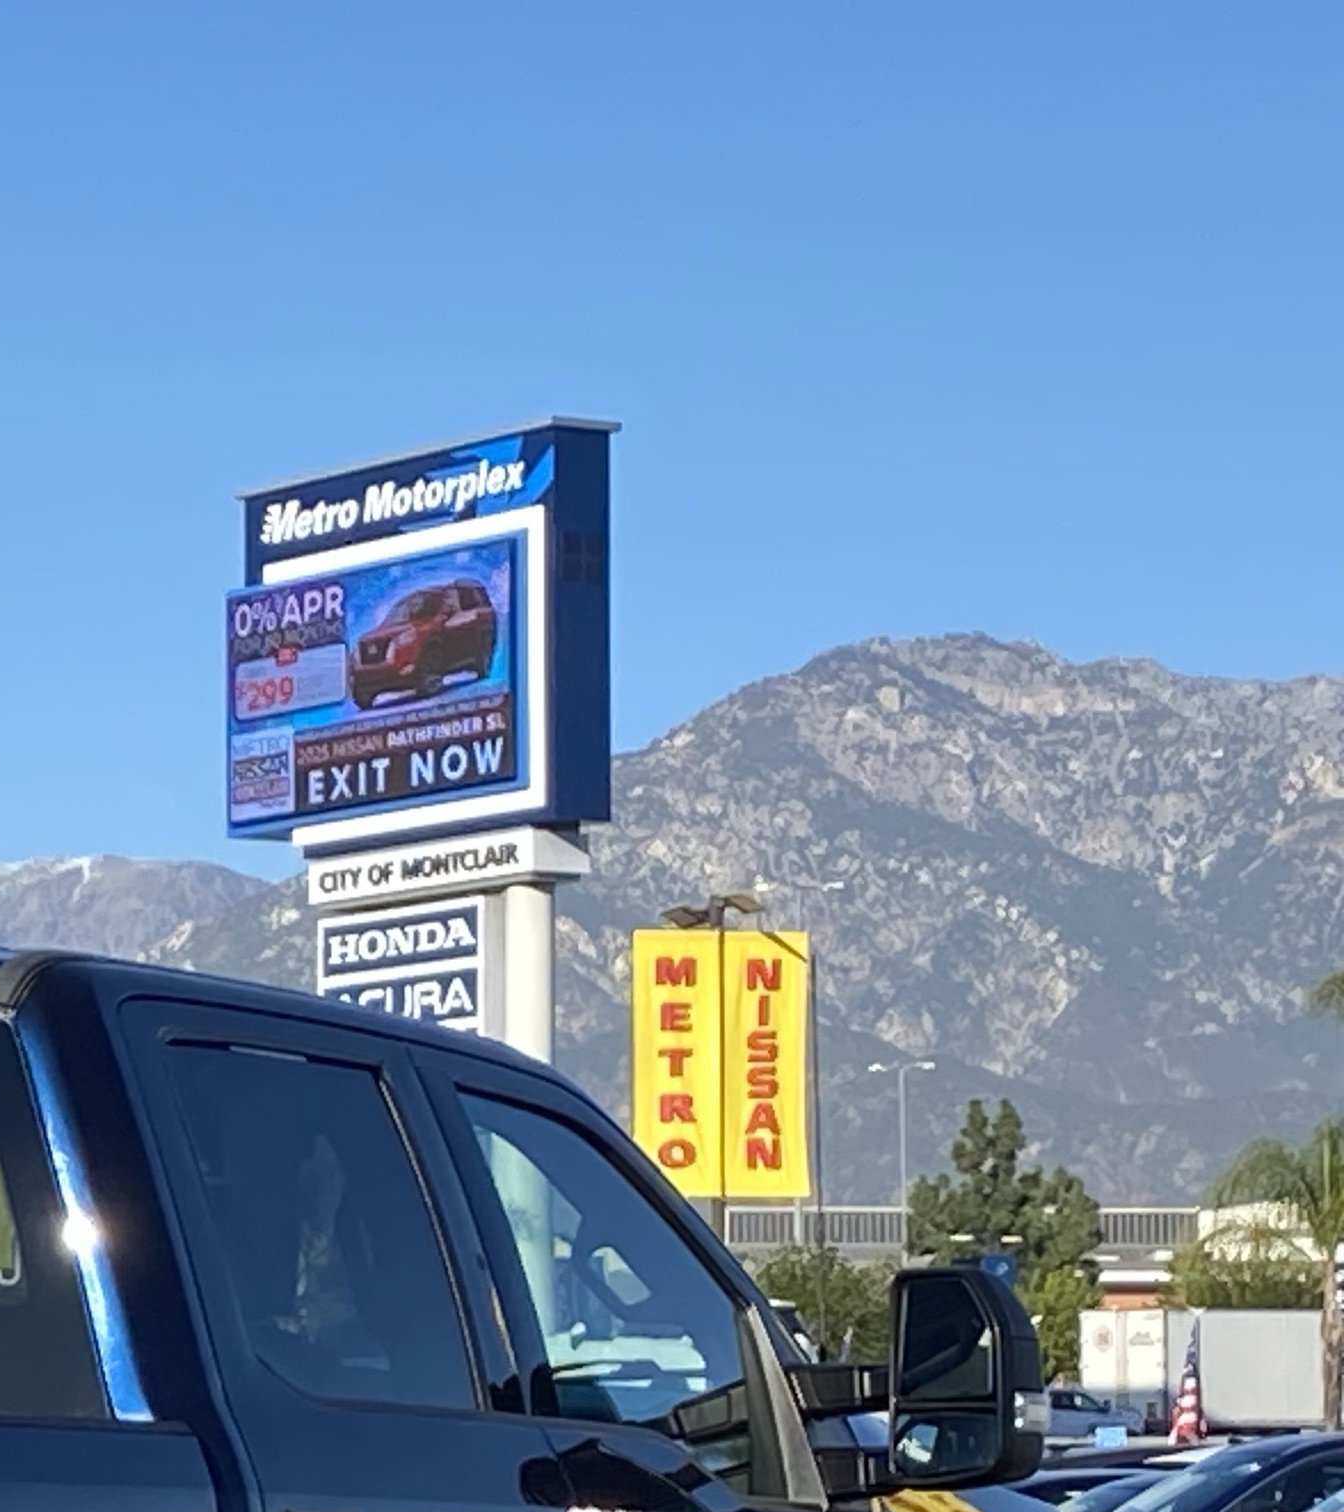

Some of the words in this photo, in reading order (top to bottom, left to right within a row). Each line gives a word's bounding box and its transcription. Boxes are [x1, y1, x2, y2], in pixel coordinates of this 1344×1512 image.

[261, 499, 359, 544] Metro
[363, 459, 525, 524] Motorplex
[234, 597, 278, 638] 0%
[280, 586, 345, 629] APR
[308, 758, 391, 804] EXIT
[410, 737, 505, 788] NOW
[319, 865, 362, 894] CITY
[368, 861, 394, 887] OF
[400, 843, 520, 882] MONTCLAIR
[328, 917, 477, 965] HONDA
[339, 976, 475, 1020] URA
[655, 956, 698, 1170] METRO
[745, 958, 784, 1171] NISSAN
